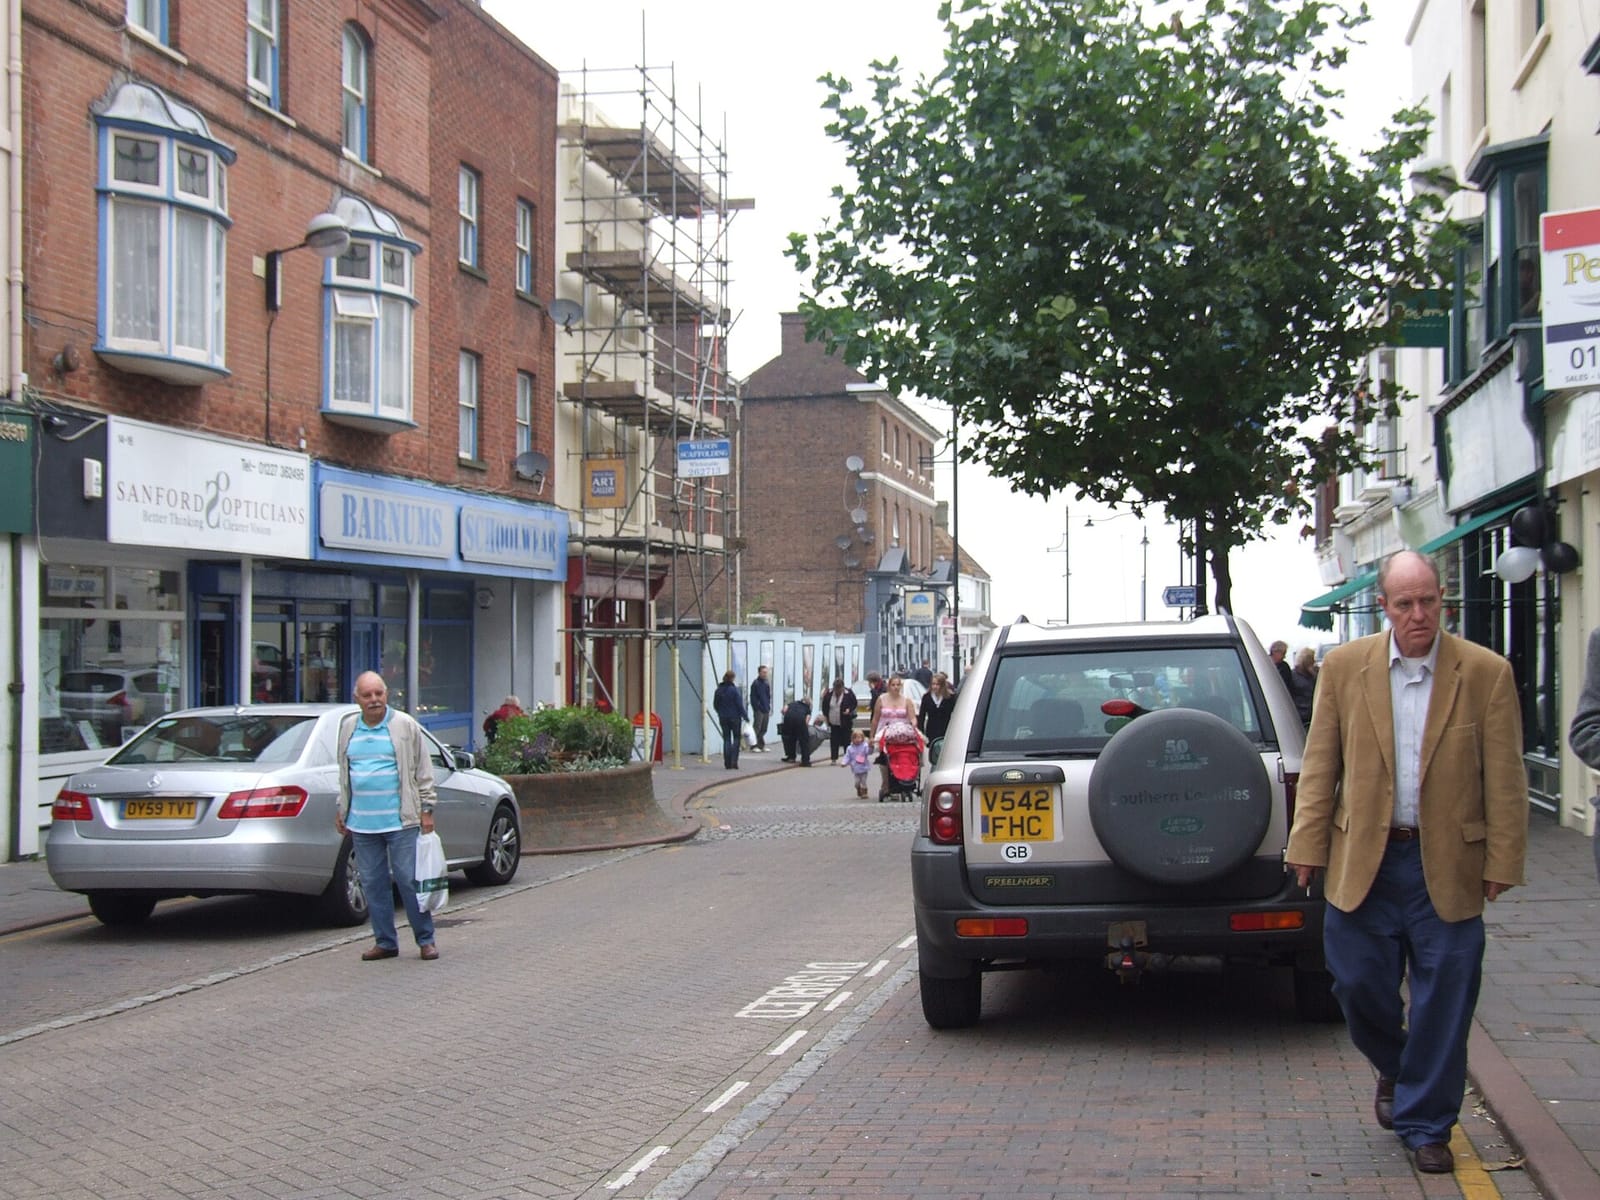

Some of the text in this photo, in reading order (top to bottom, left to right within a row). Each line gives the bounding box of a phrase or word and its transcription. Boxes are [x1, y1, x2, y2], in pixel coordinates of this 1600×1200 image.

[1565, 374, 1589, 383] SALES
[690, 442, 718, 450] WILSON
[680, 450, 729, 458] SCAFFOLDING
[592, 477, 615, 487] ART
[117, 481, 204, 512] SANFORD
[222, 497, 305, 525] OPTICIANS
[142, 510, 168, 524] Better
[169, 512, 204, 531] Thinking
[341, 493, 556, 561] BARNUMS SCHOOLWEAR
[1165, 739, 1189, 754] 50
[983, 790, 1050, 812] V542
[1110, 789, 1178, 806] outhern
[168, 800, 194, 815] TVT
[992, 815, 1042, 837] FHC
[1005, 846, 1028, 859] GB
[986, 877, 1051, 887] FREELANDER
